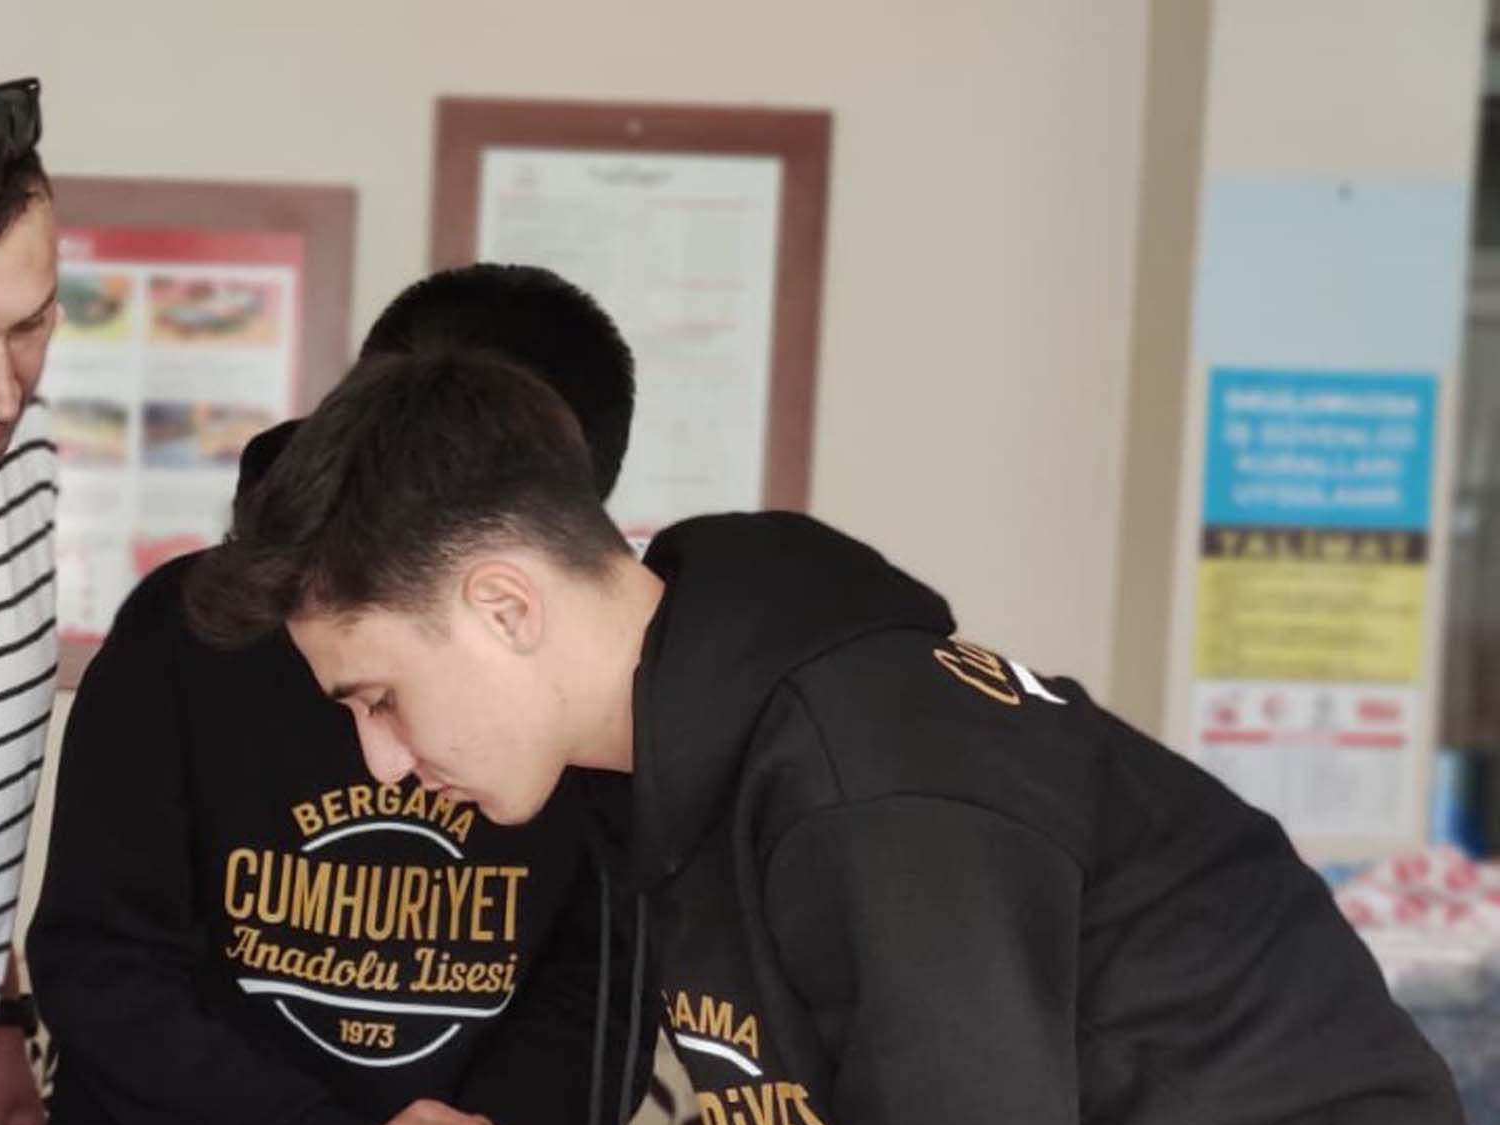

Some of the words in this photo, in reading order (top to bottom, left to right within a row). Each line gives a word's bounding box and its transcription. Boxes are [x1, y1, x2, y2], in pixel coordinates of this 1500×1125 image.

[291, 783, 476, 844] BERGAMA
[225, 925, 401, 991] Anadolu
[410, 947, 519, 994] Lisesi
[339, 1018, 396, 1049] 1973
[661, 989, 760, 1059] AMA
